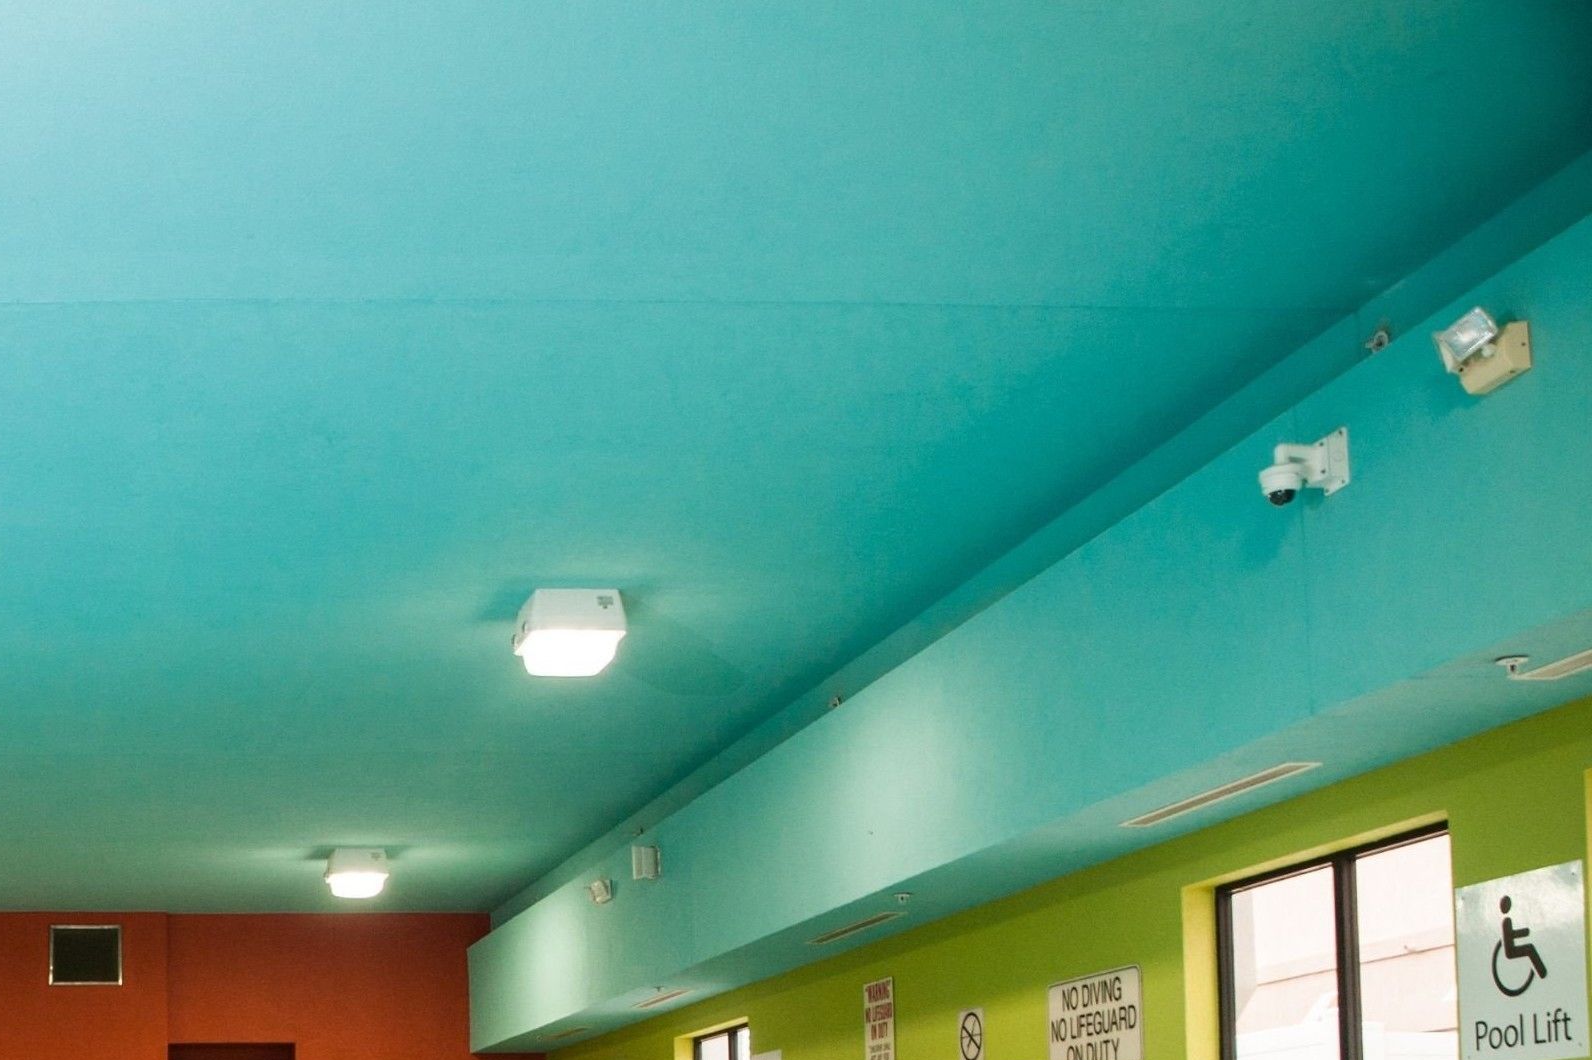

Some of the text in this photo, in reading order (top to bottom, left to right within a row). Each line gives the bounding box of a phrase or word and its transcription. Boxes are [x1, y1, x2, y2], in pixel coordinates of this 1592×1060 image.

[1061, 976, 1122, 1012] NO DIVING
[1051, 1004, 1137, 1043] NO LIFEGUARD
[1475, 1008, 1572, 1051] Pool Lift
